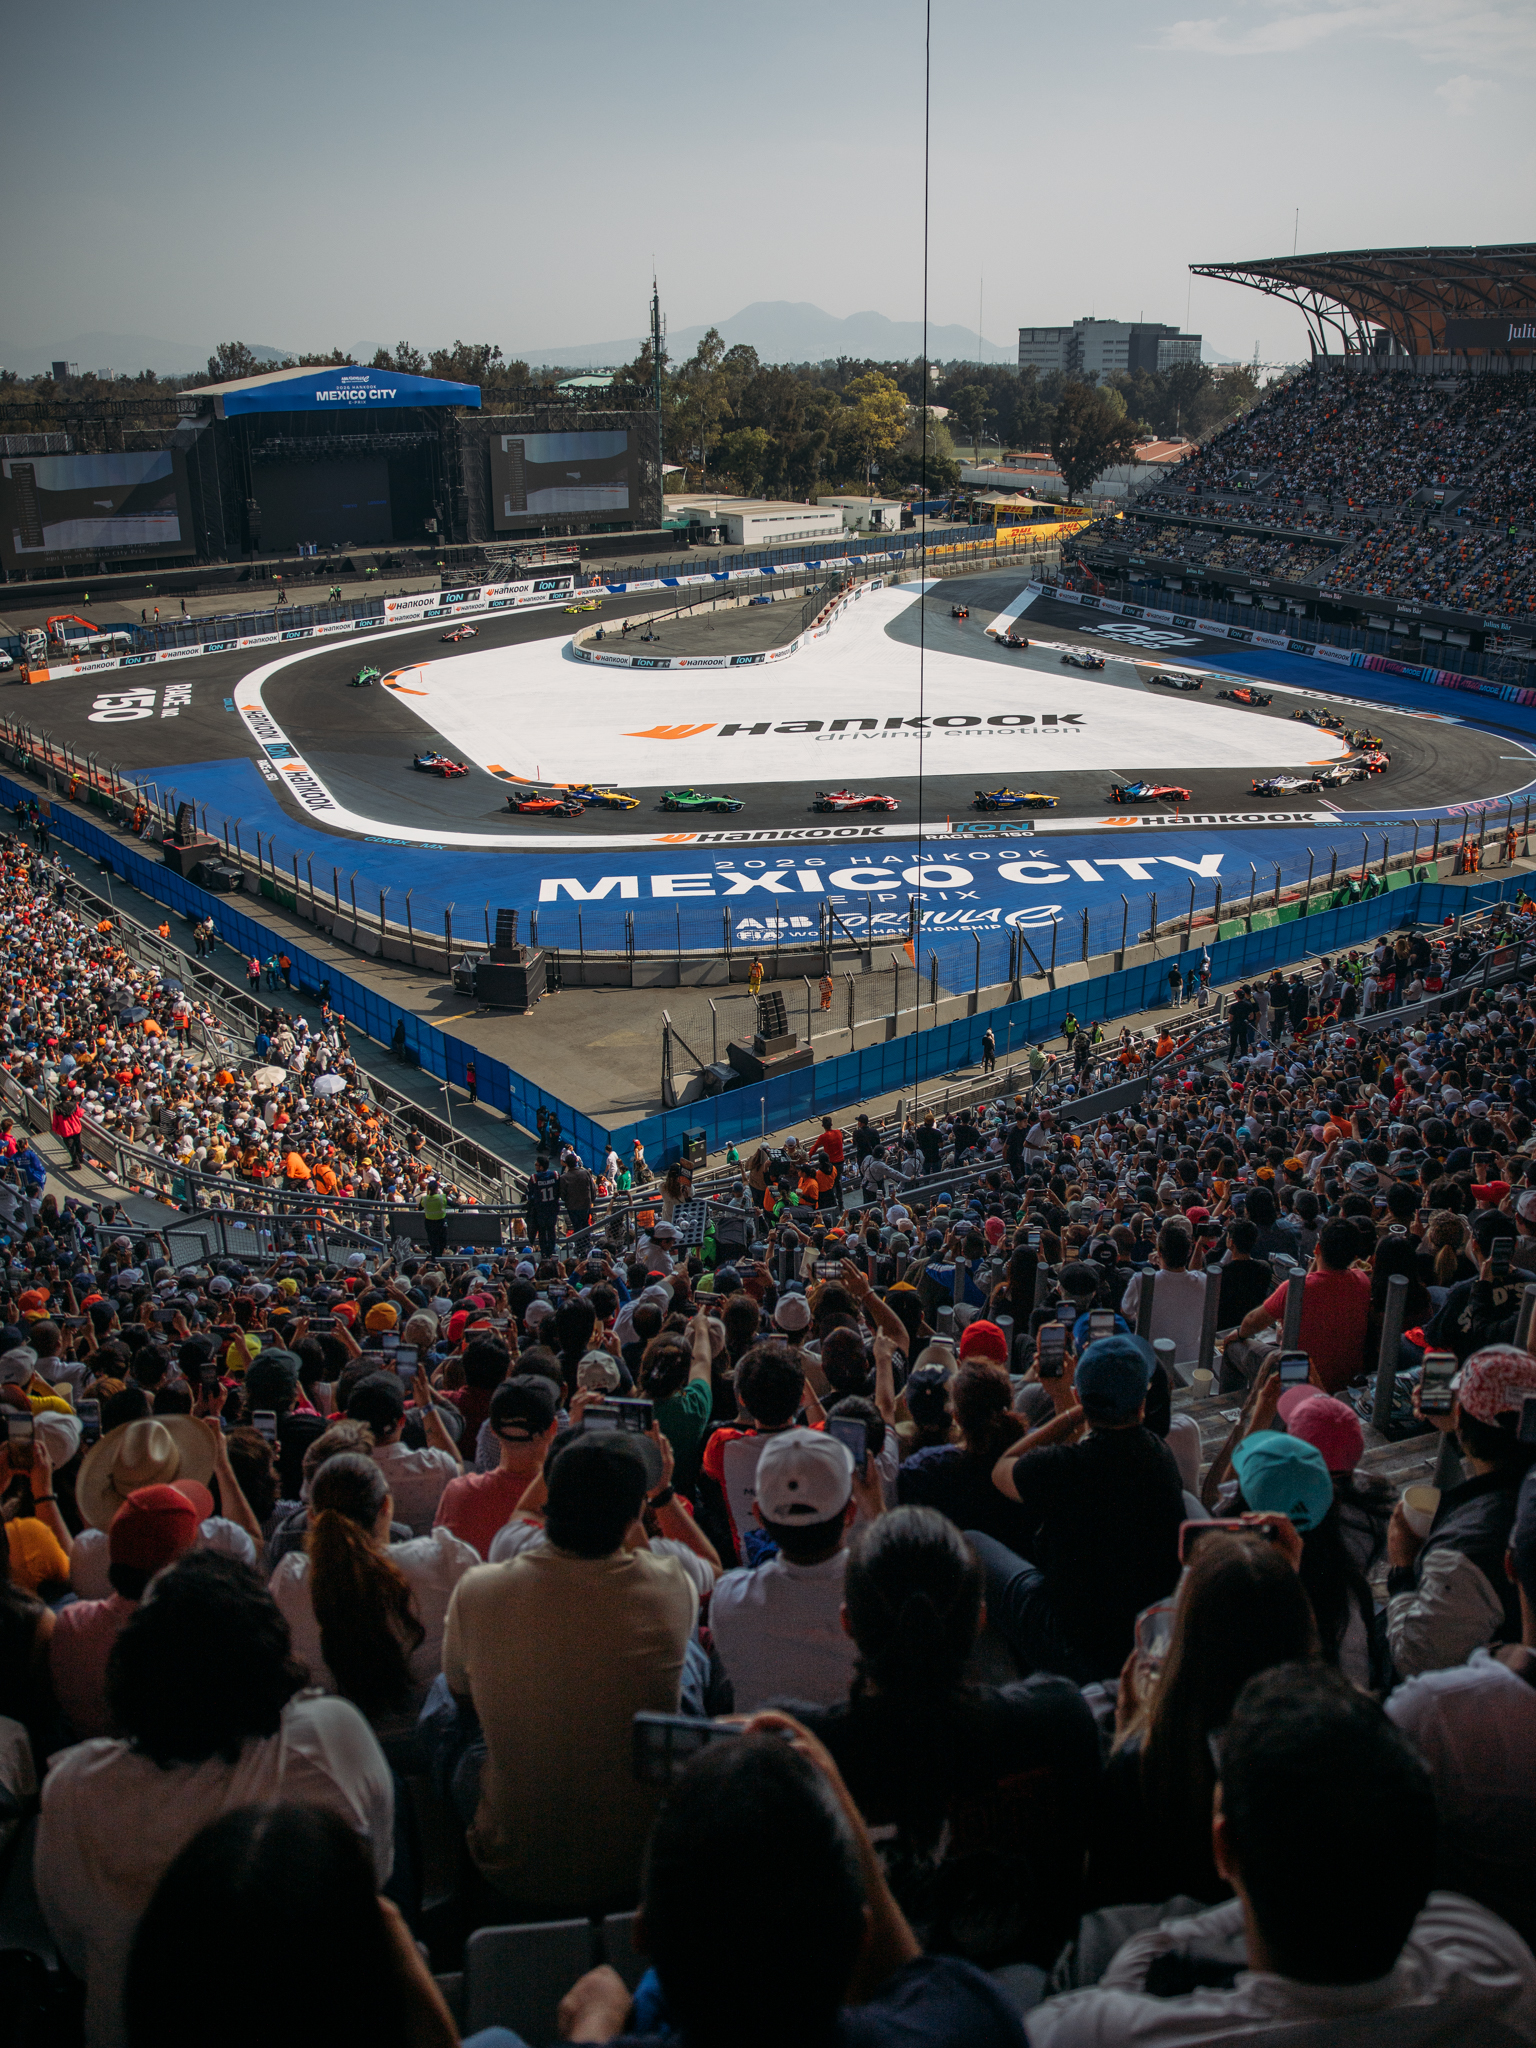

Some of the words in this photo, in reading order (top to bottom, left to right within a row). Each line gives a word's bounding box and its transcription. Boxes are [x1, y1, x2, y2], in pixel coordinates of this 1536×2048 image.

[316, 389, 367, 402] MEXICO
[369, 388, 397, 400] CITY
[1002, 504, 1028, 514] DHL
[1059, 506, 1084, 516] DHL
[1011, 527, 1033, 537] DHL
[1397, 604, 1412, 614] Julius
[1413, 606, 1423, 615] Bär
[1483, 619, 1500, 629] Julius
[1500, 622, 1512, 631] Bär
[1096, 632, 1170, 650] RACE
[1097, 622, 1204, 647] 150
[163, 683, 193, 707] RACE
[87, 687, 157, 723] 150
[814, 729, 932, 742] driving
[944, 726, 1081, 737] emotion
[925, 832, 976, 841] RACE
[1000, 830, 1035, 839] 150
[715, 857, 827, 870] 2026
[850, 848, 1050, 866] HANKOOK
[538, 864, 974, 902] MEXICO
[997, 853, 1225, 885] CITY
[826, 889, 981, 905] E-PRIX
[735, 915, 813, 930] ABB
[829, 906, 1002, 928] FORMULA
[740, 929, 780, 941] FIA
[788, 929, 847, 938] WORLD
[860, 923, 1002, 936] CHAMPIONSHIP
[540, 1186, 555, 1202] 11
